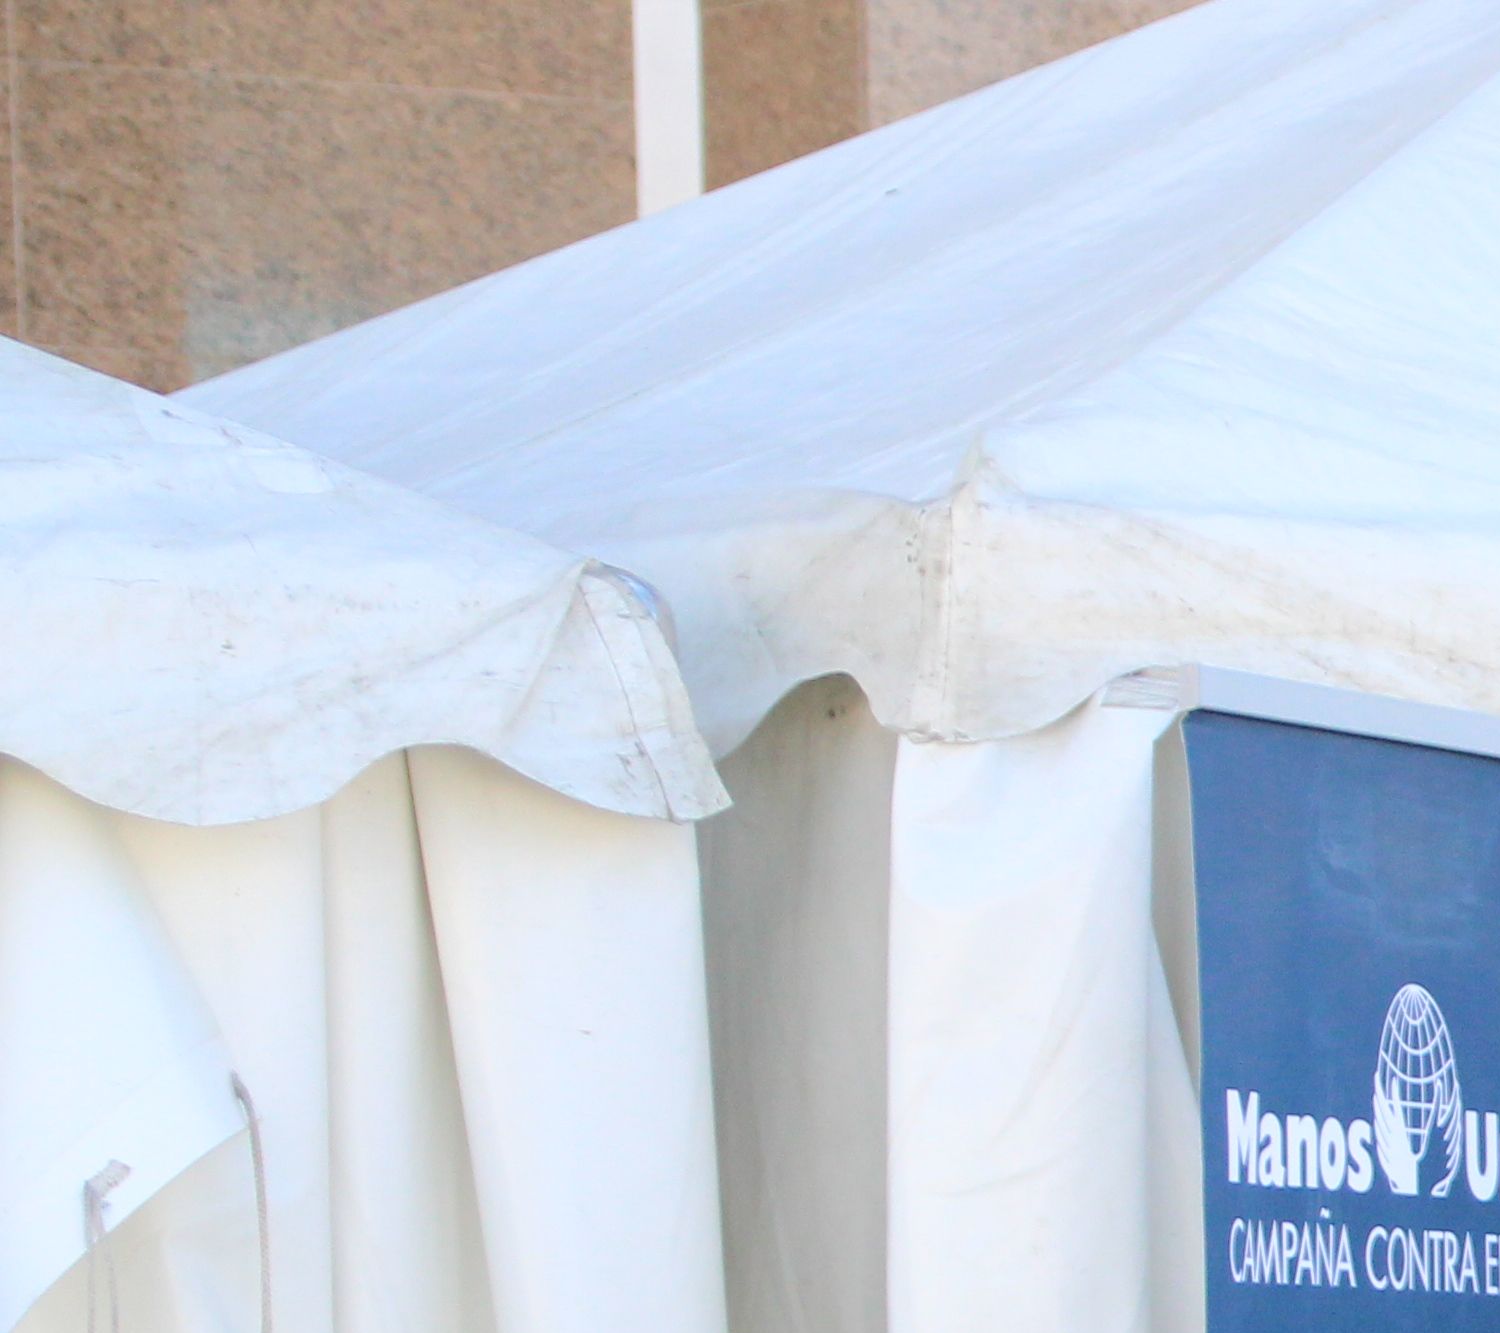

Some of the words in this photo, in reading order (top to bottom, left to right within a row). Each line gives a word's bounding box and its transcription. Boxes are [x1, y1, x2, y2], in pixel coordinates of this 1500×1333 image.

[1226, 1087, 1374, 1194] Manos
[1229, 1207, 1357, 1289] CAMPAÑA
[1365, 1225, 1478, 1294] CONTRA
